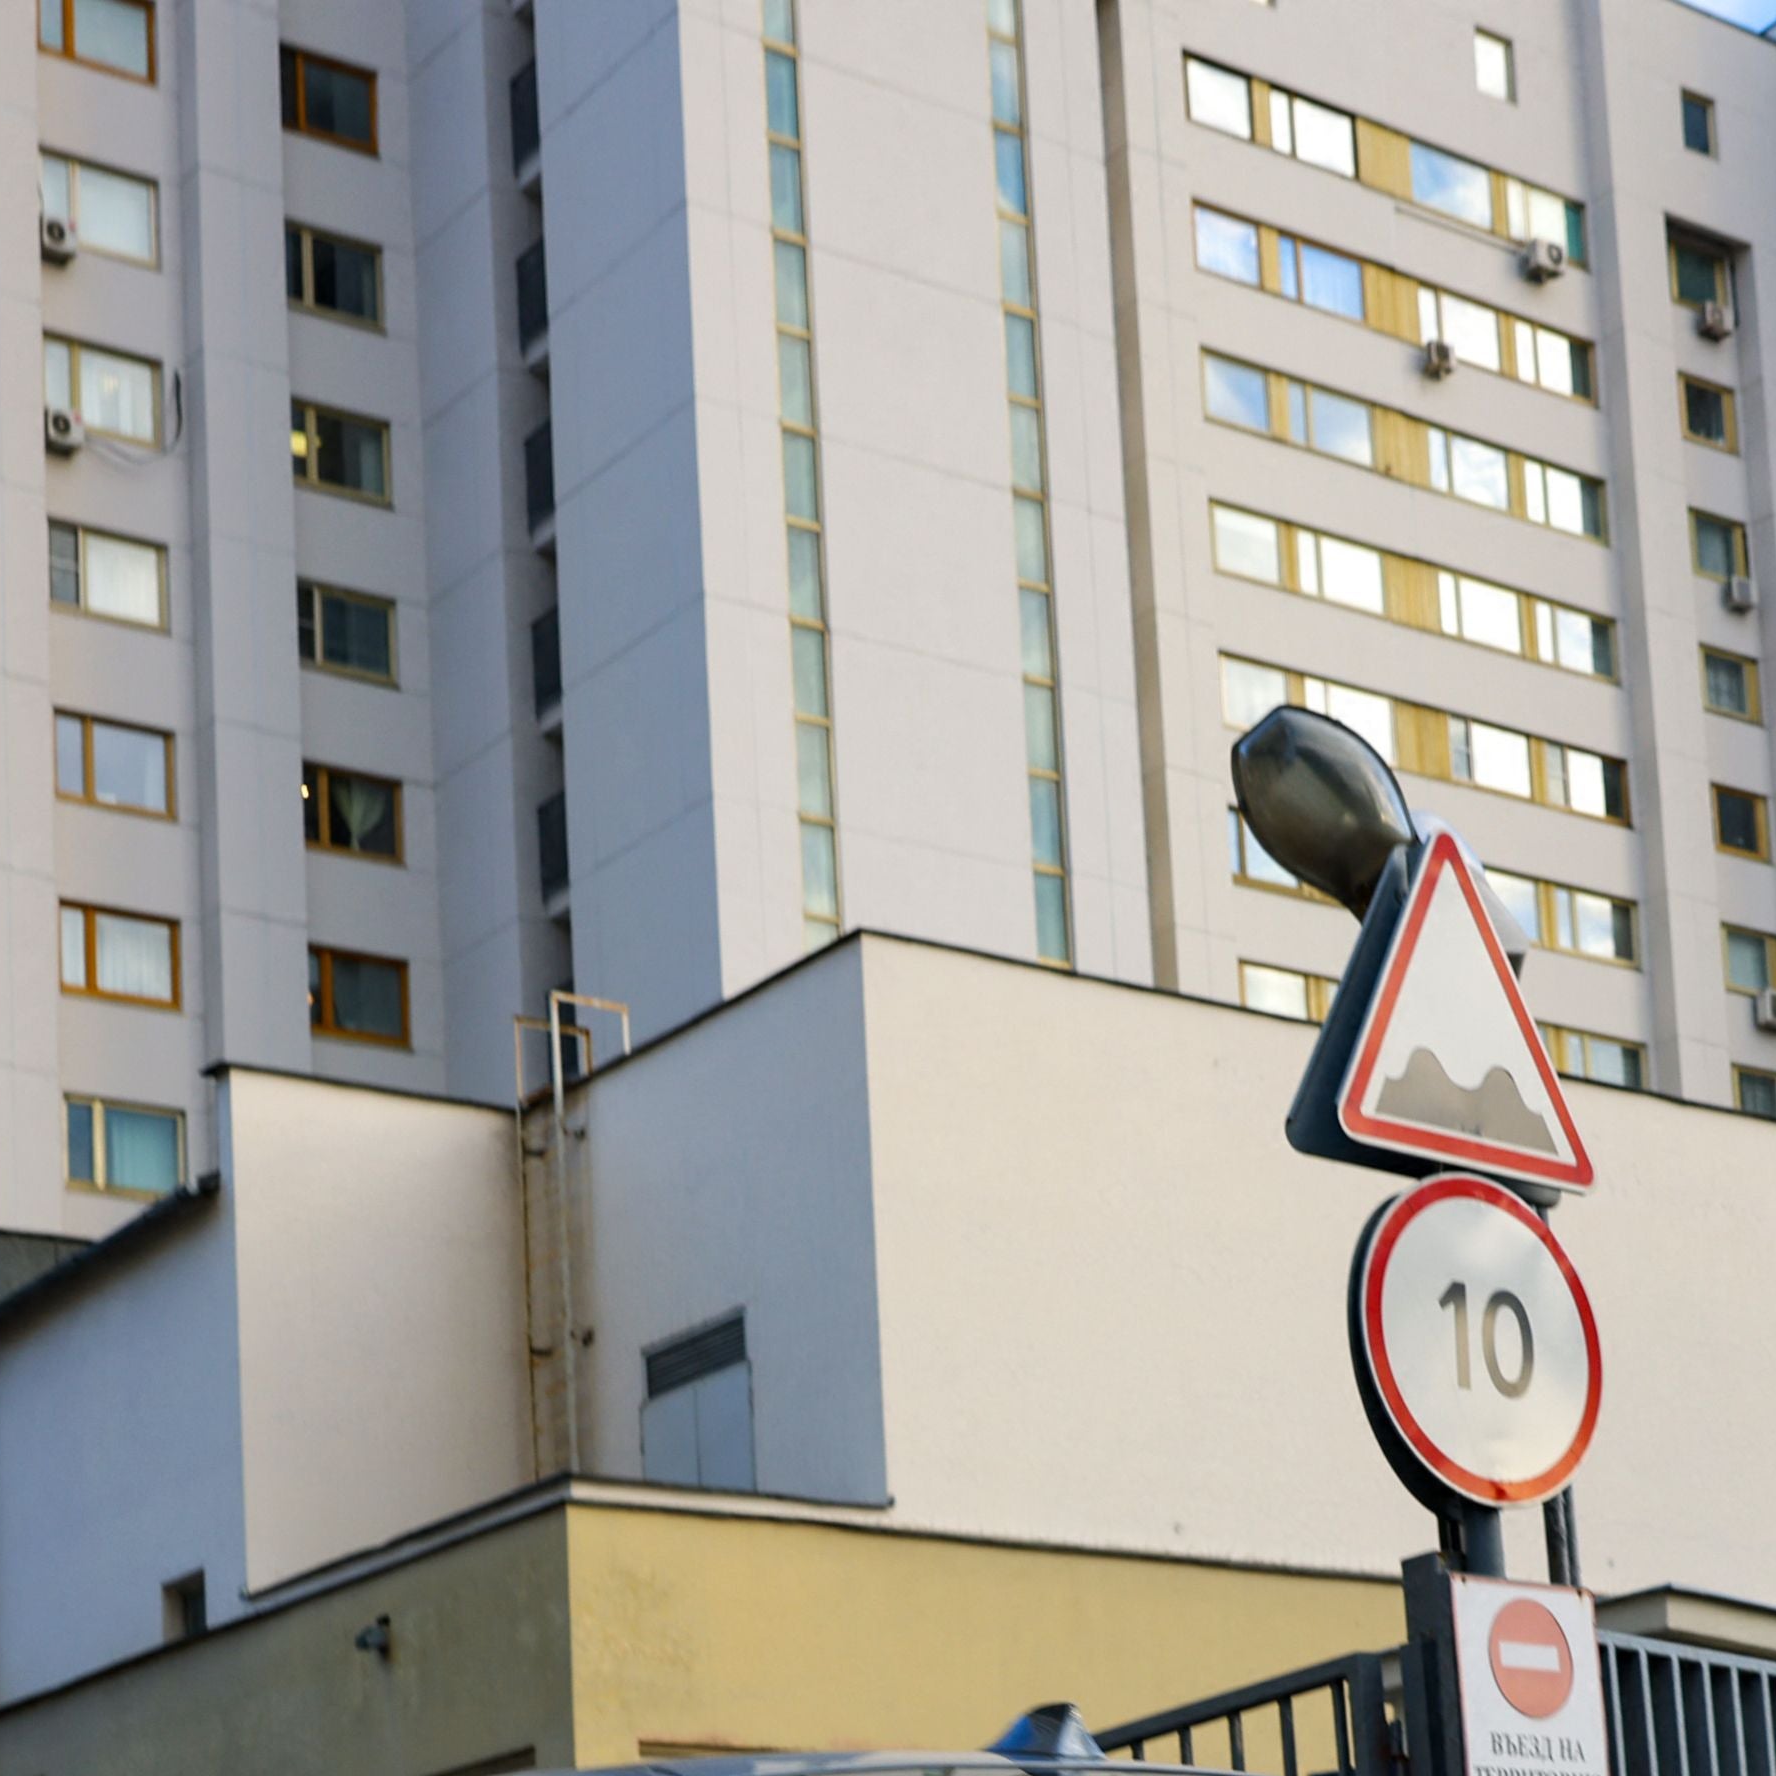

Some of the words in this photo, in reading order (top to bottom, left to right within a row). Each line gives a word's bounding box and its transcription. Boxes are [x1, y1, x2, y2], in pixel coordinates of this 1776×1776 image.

[1438, 1280, 1534, 1400] 10
[1489, 1730, 1554, 1763] ВЪЕЗД
[1558, 1736, 1586, 1763] НА
